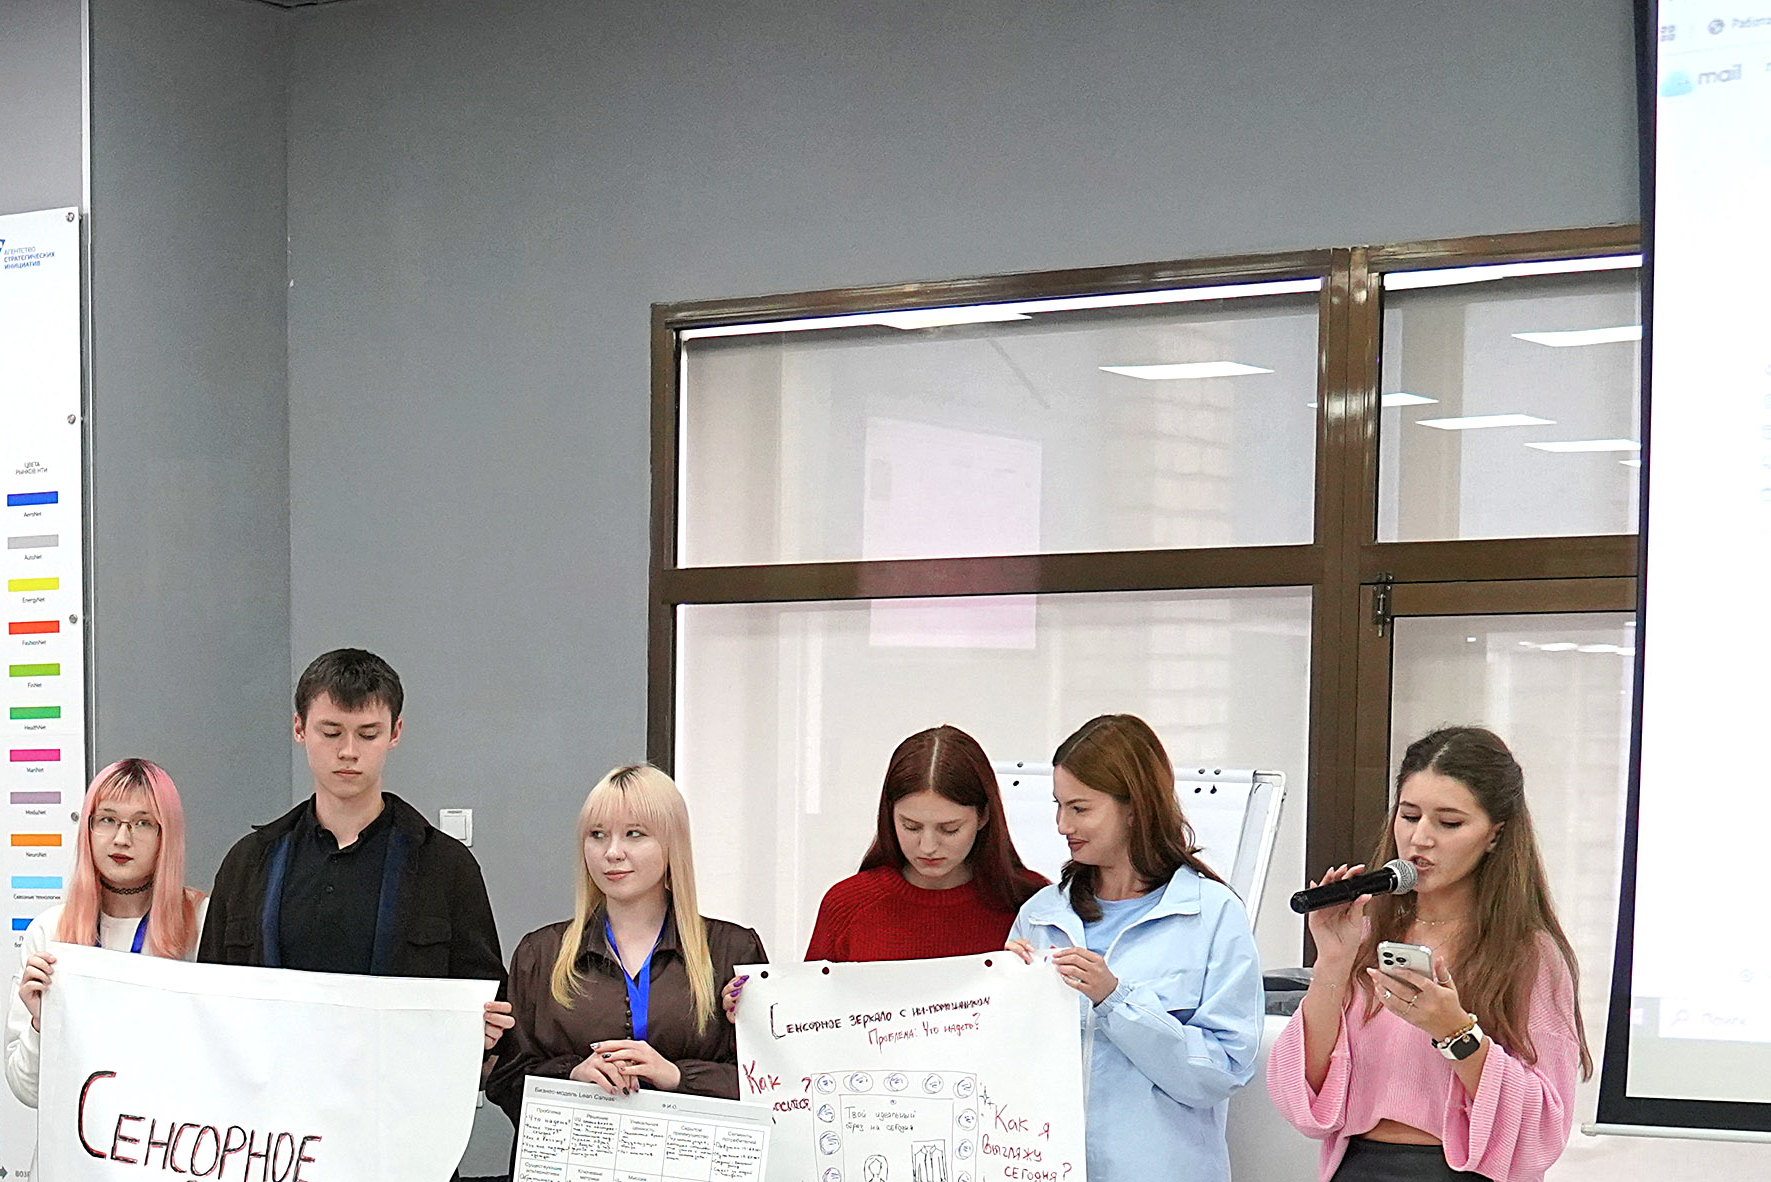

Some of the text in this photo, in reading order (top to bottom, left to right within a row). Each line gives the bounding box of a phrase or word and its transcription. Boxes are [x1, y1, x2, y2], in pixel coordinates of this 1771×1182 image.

[4, 252, 55, 263] СТРАТЕГИЧЕСКИХ
[4, 261, 41, 270] ИНИЦИАТИВ
[850, 1011, 892, 1028] ЗЕРКАЛО
[743, 1060, 780, 1094] Как
[534, 1087, 615, 1101] Бизнес-модель Lean Canvas
[844, 1106, 916, 1121] Твой идеальный
[995, 1104, 1050, 1141] Как я
